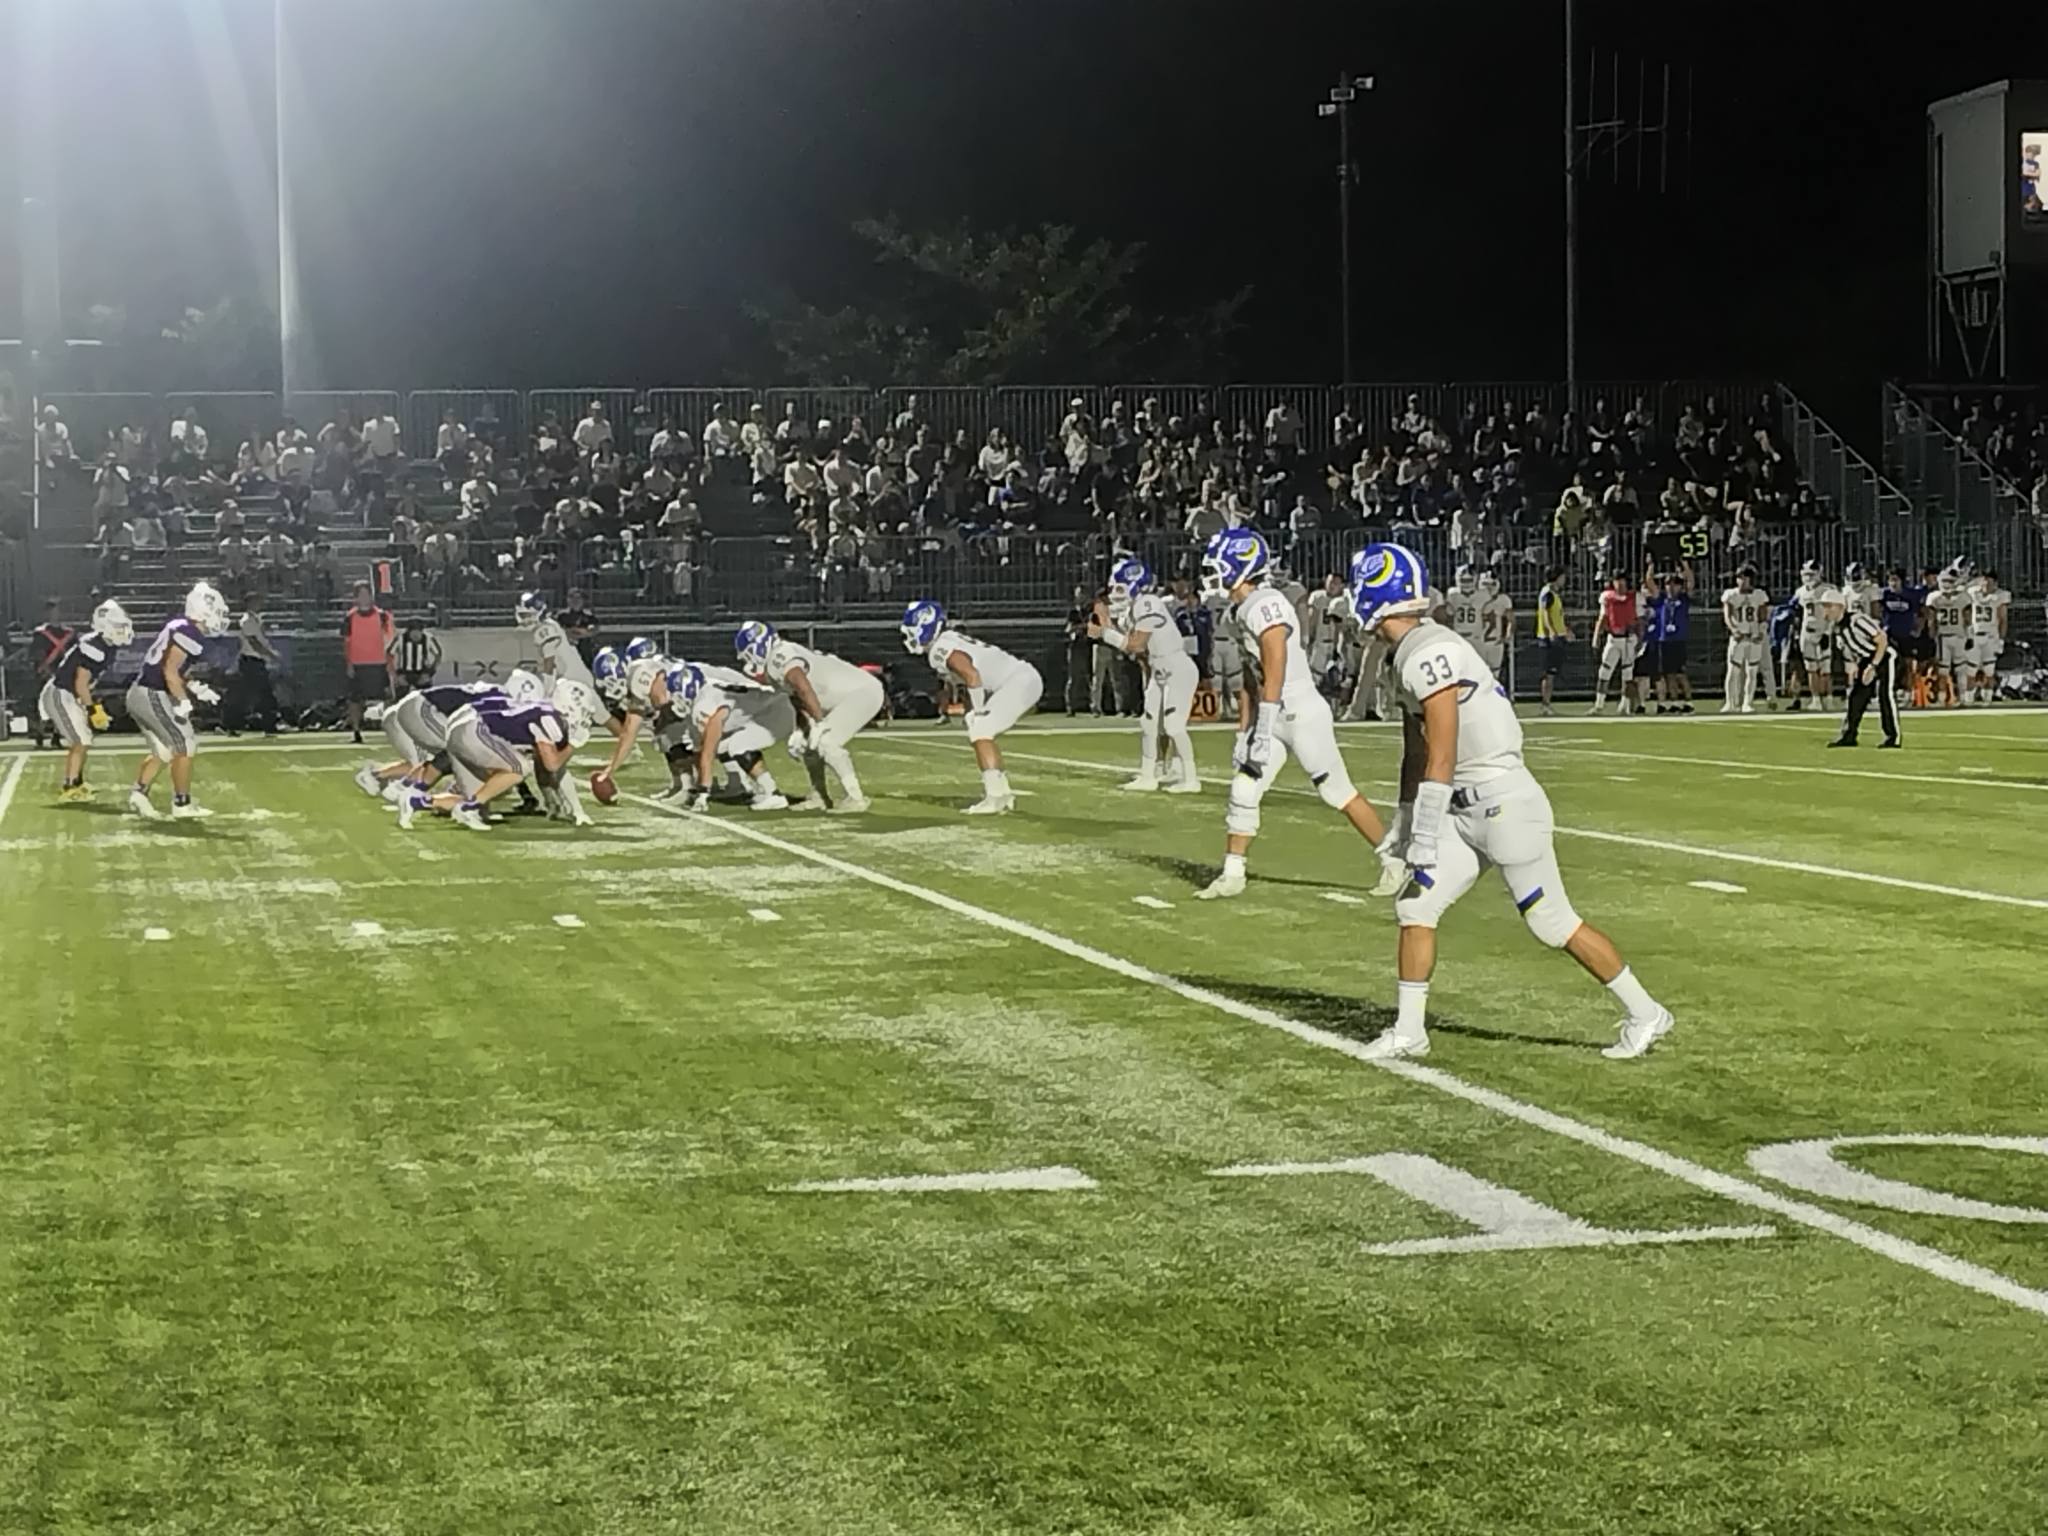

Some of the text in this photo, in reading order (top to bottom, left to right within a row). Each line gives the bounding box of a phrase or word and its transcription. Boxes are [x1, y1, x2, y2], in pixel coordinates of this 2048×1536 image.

[1679, 533, 1708, 557] 53
[1260, 602, 1283, 623] 83
[1456, 606, 1477, 624] 36
[1737, 606, 1756, 624] 18
[1420, 654, 1453, 686] 33
[1190, 691, 1217, 718] 20
